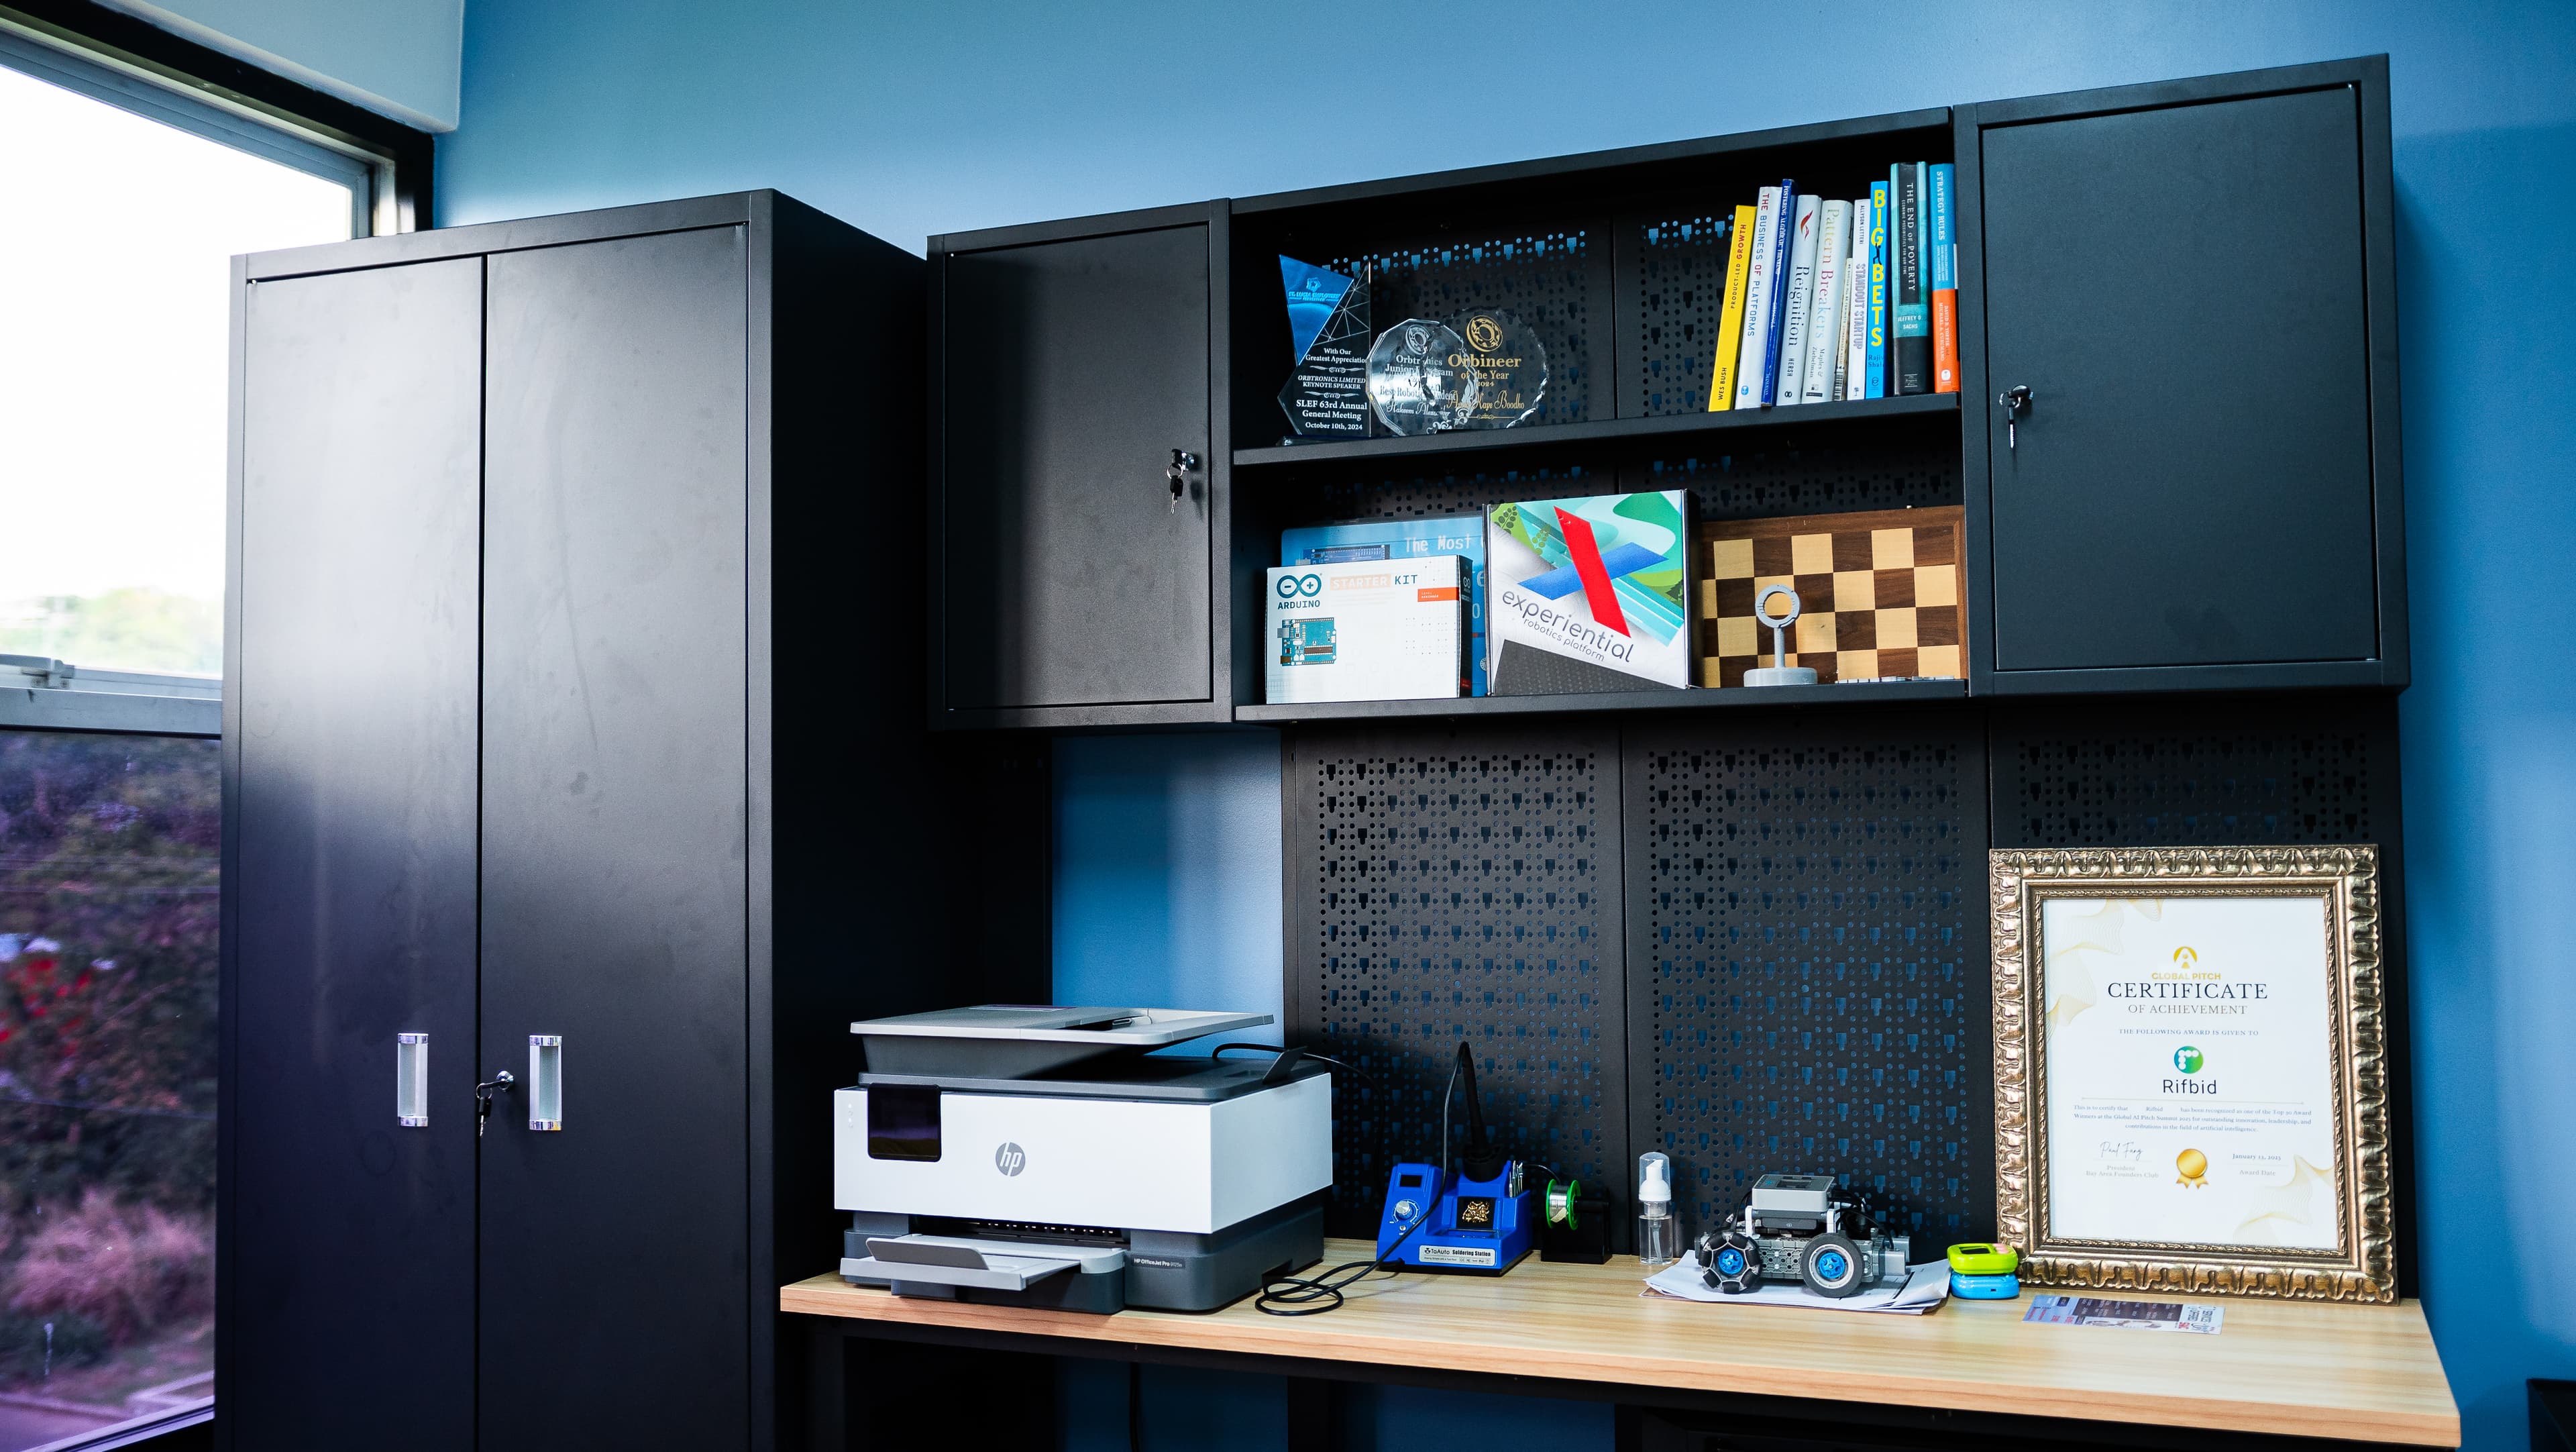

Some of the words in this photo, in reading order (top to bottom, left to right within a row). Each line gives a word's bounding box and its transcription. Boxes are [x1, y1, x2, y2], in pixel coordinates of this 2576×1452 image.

[1761, 193, 1770, 211] THE
[1937, 171, 1945, 213] STRATEGY
[1871, 189, 1886, 246] BIG
[1756, 215, 1767, 260] BUSINESS
[1823, 209, 1839, 263] Pattern
[1907, 232, 1913, 242] OF
[1731, 263, 1741, 309] PRODUCT-LED
[1736, 224, 1746, 259] GROWTH
[1754, 264, 1762, 276] OF
[1855, 263, 1866, 308] STANDOUT
[1748, 280, 1760, 336] PLATFORMS
[1788, 266, 1810, 346] Reignition
[1815, 270, 1833, 338] Breakers
[1871, 263, 1884, 347] BETS
[1853, 311, 1864, 349] STARTUP
[1448, 354, 1522, 367] Orbineer
[1786, 358, 1795, 376] HERSH
[1817, 348, 1825, 369] Maples
[1461, 370, 1470, 380] of
[1490, 370, 1509, 379] Year
[1296, 399, 1318, 407] SLEF
[1320, 401, 1338, 409] 63rd
[1332, 411, 1362, 421] Meeting
[1405, 537, 1428, 553] The
[1438, 533, 1470, 550] Most
[1333, 576, 1387, 589] STARTER
[1395, 574, 1417, 585] KIT
[1277, 600, 1320, 610] ARDUINO
[1502, 590, 1634, 663] experiential
[1523, 617, 1562, 641] robotics
[1563, 637, 1605, 662] platform
[2151, 972, 2190, 980] GLOBAL
[2108, 982, 2268, 999] CERTIFICATE
[2128, 1004, 2146, 1014] OF
[2149, 1004, 2248, 1015] ACHIEVEMENT
[2162, 1079, 2217, 1094] Rifbid
[999, 1141, 1023, 1176] hp
